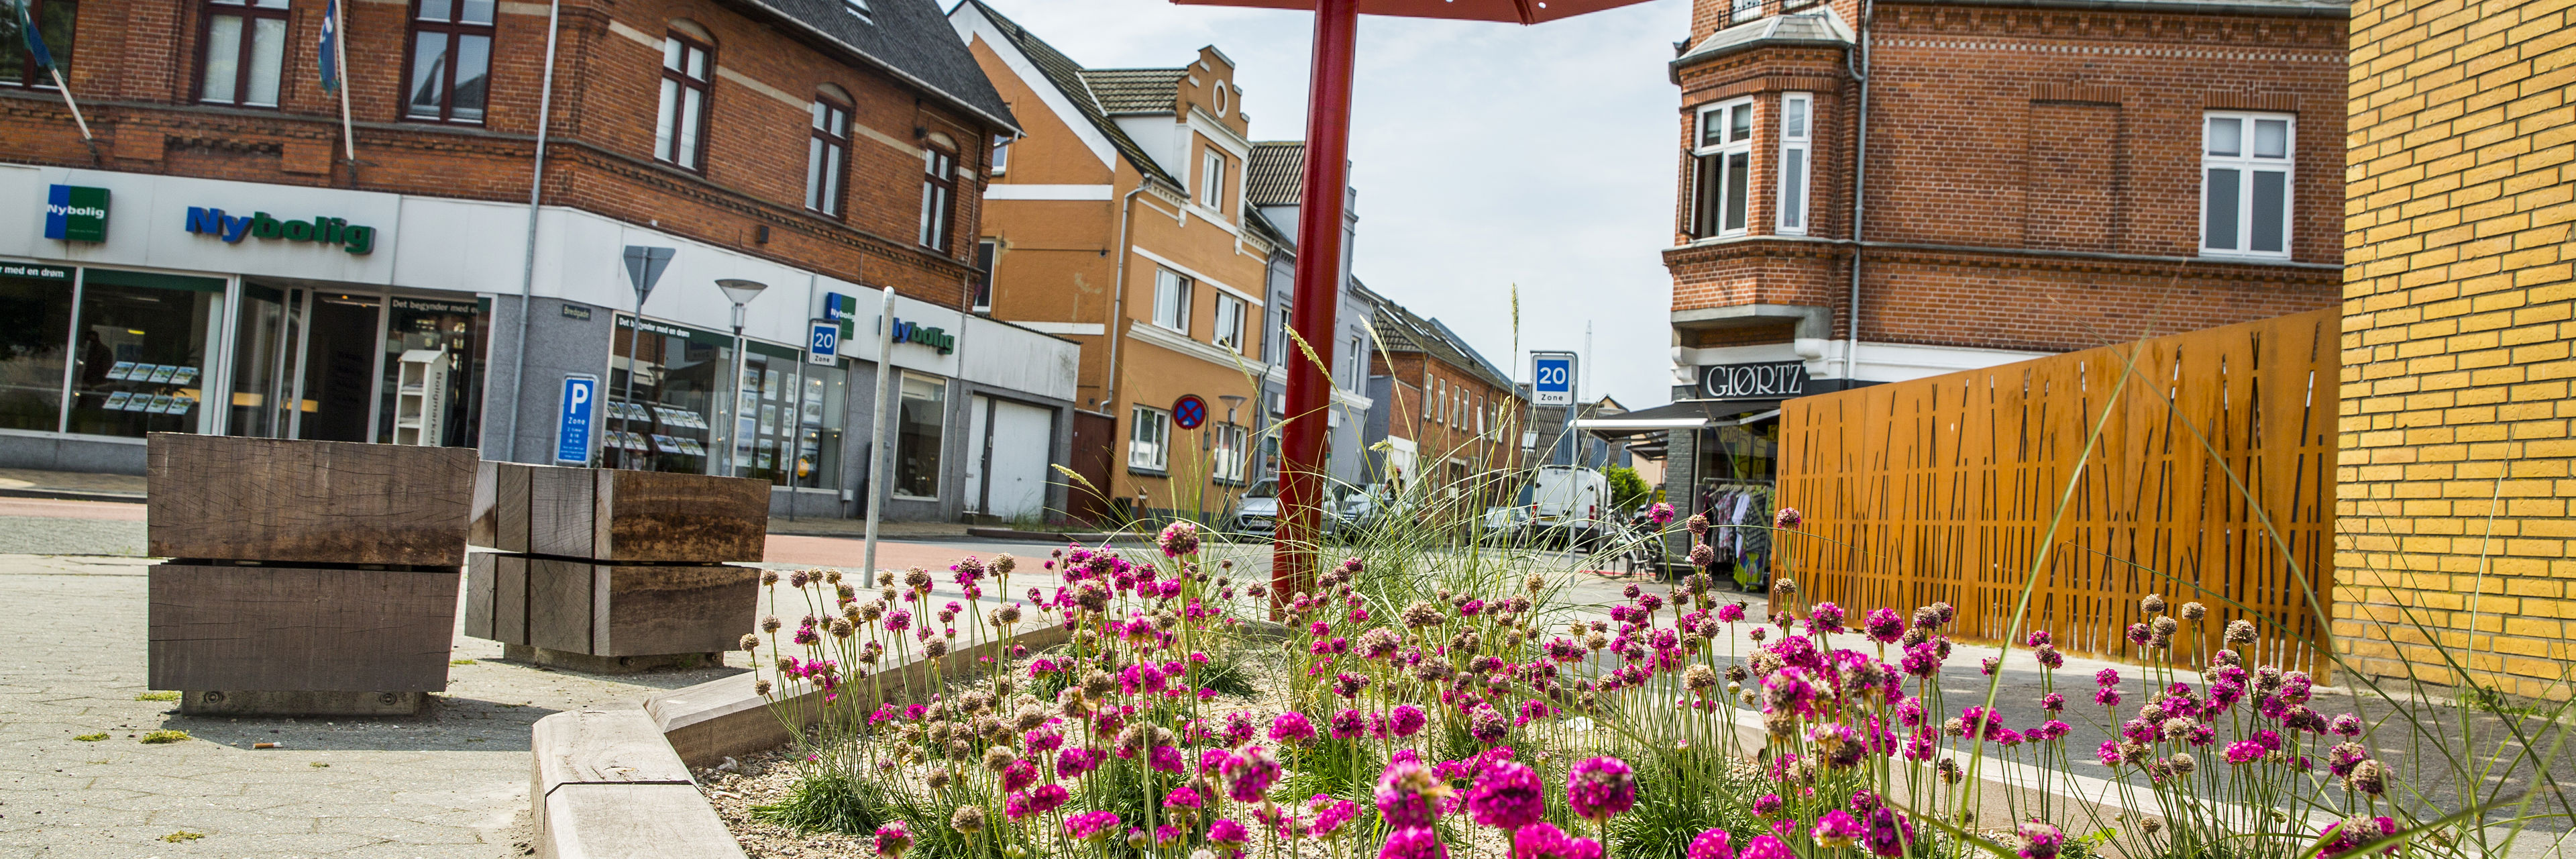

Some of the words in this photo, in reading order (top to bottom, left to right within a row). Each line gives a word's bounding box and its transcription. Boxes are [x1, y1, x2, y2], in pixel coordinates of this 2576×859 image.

[47, 204, 105, 219] Nybolig
[186, 206, 375, 254] Nybolig
[5, 266, 25, 274] med
[41, 268, 64, 278] drøm
[392, 299, 407, 308] Det
[409, 301, 448, 311] begynder
[450, 305, 469, 313] med
[830, 308, 856, 322] Nybolig
[619, 317, 629, 326] Det
[630, 319, 655, 331] bgynder
[656, 326, 668, 334] med
[814, 333, 833, 348] 20
[1540, 367, 1566, 385] 20
[1707, 364, 1803, 397] GIØRTZ
[570, 383, 588, 414] P
[568, 417, 586, 425] Zone
